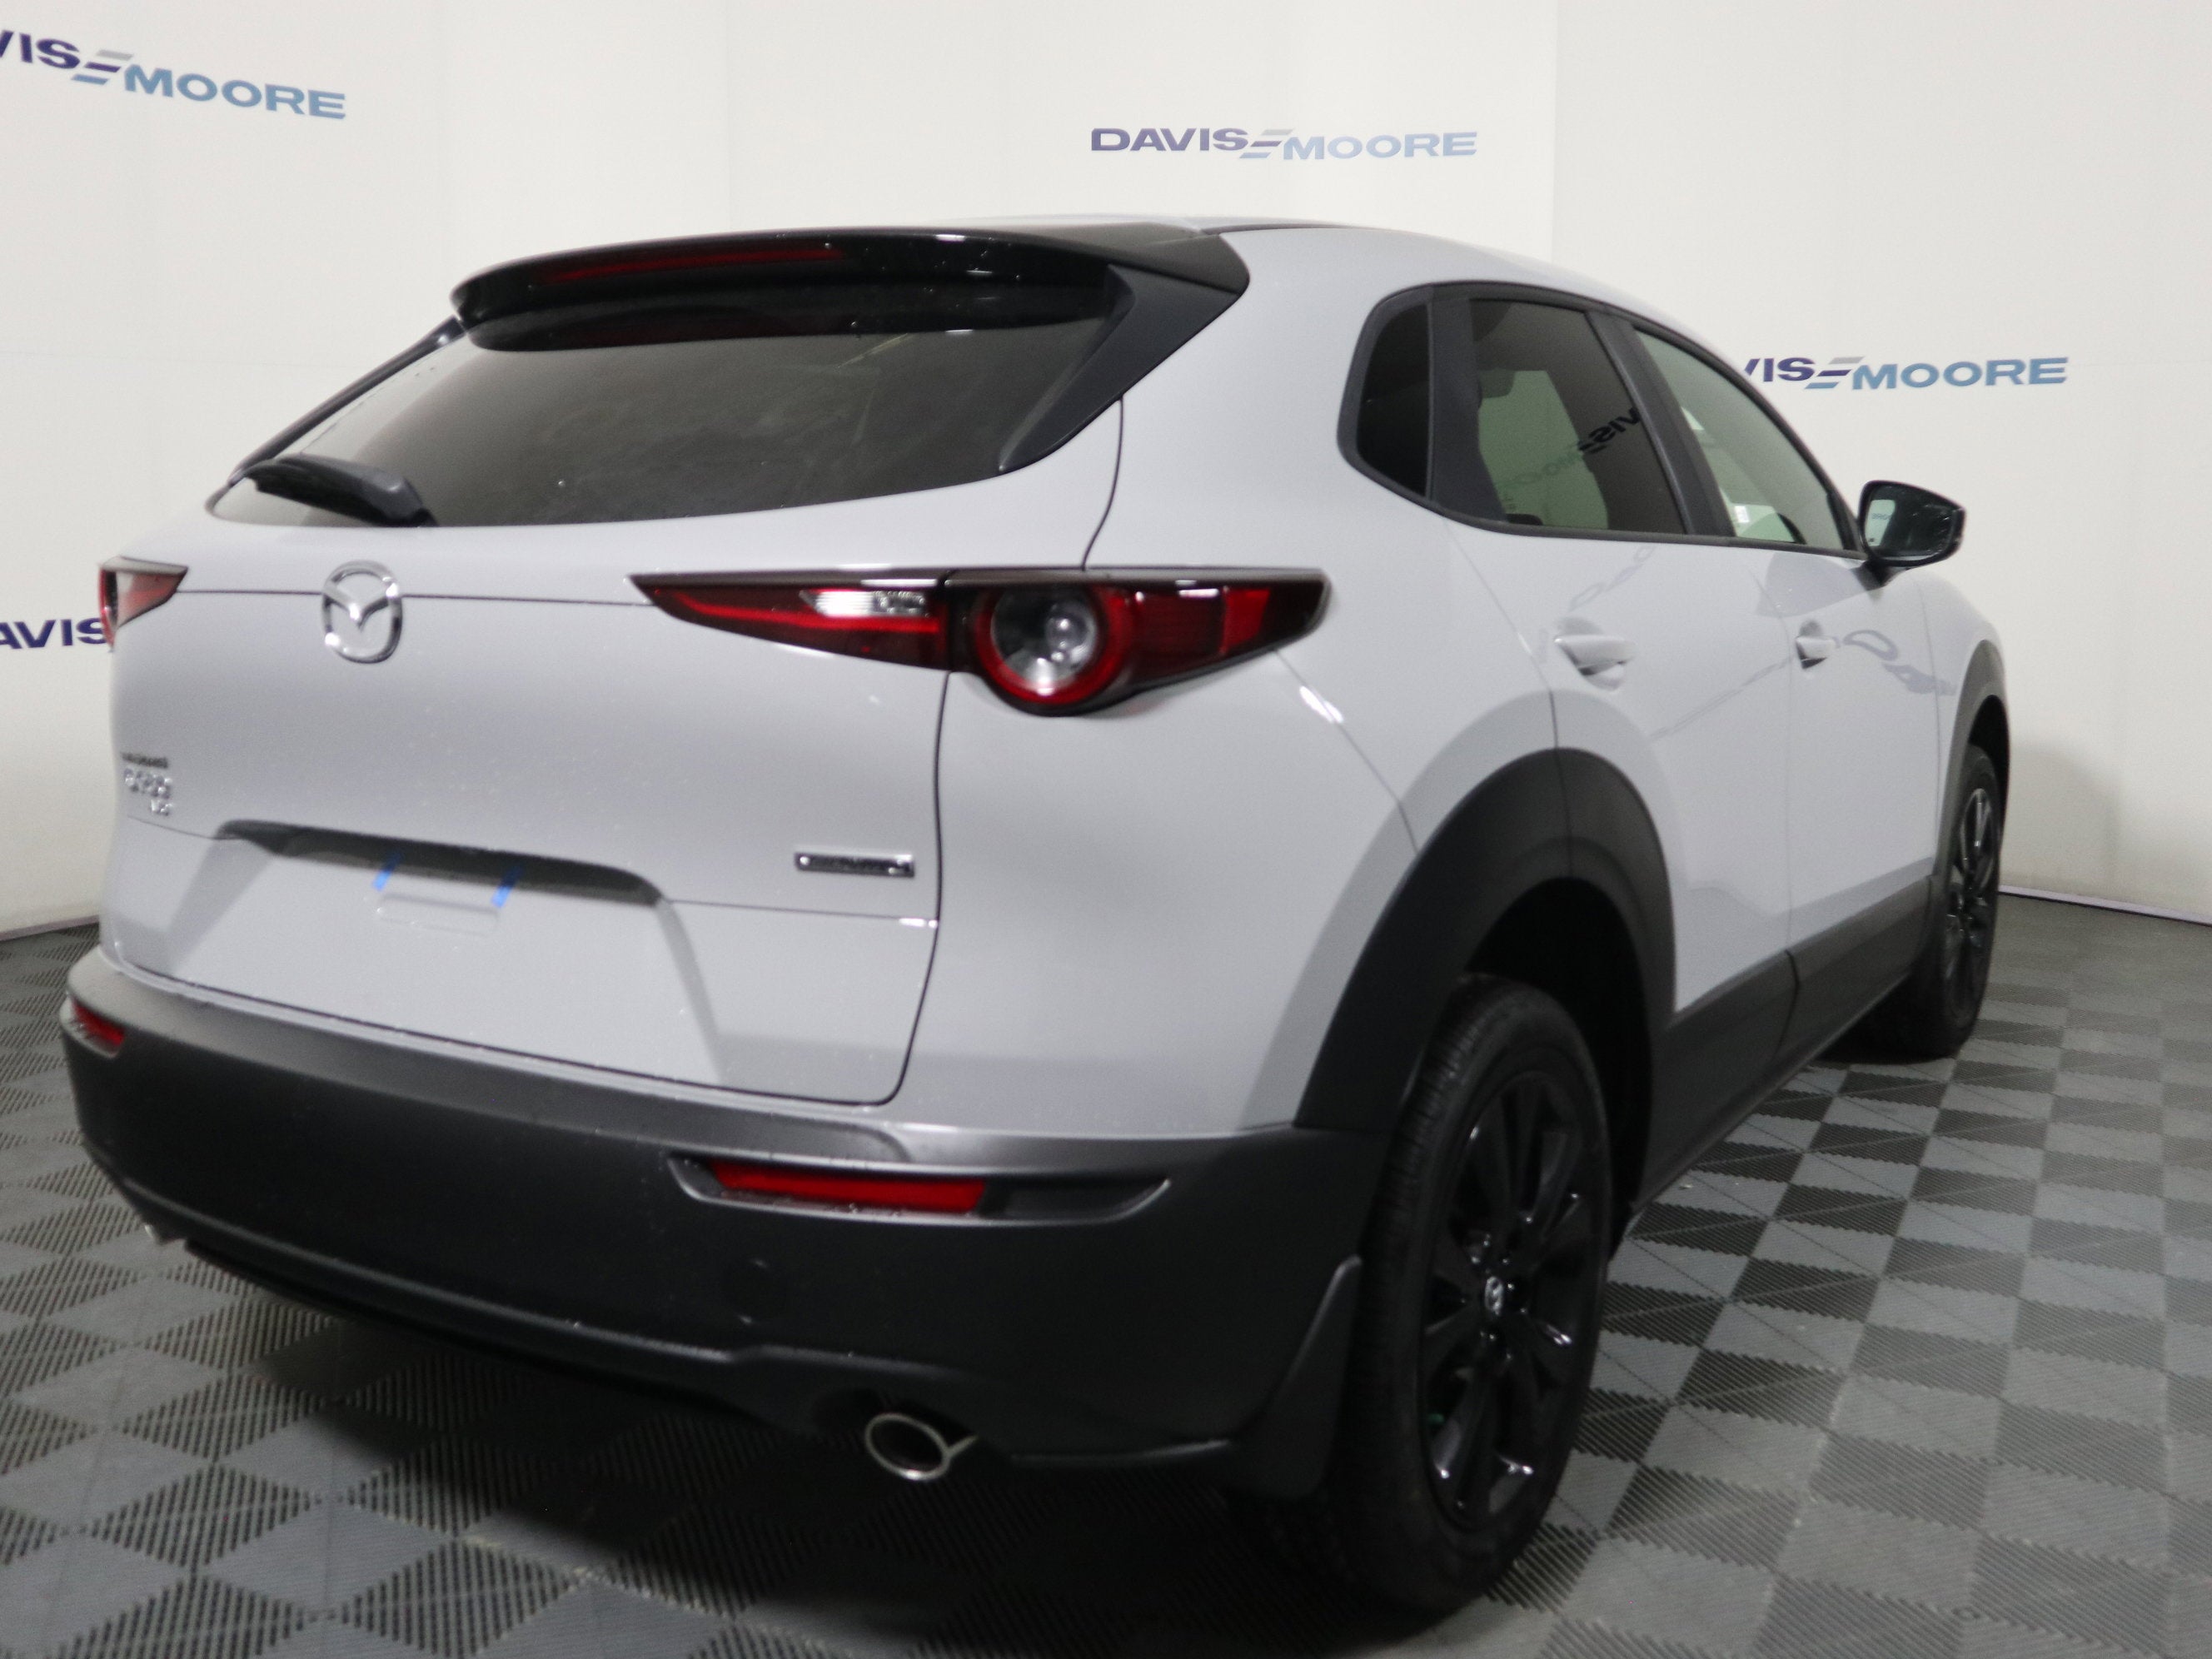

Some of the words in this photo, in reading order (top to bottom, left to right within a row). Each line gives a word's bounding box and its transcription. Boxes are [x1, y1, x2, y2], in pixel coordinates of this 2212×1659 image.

[124, 64, 346, 120] MOORE
[1091, 127, 1248, 152] DAVIS
[1283, 131, 1477, 160] MOORE
[1851, 356, 2069, 391] MOORE
